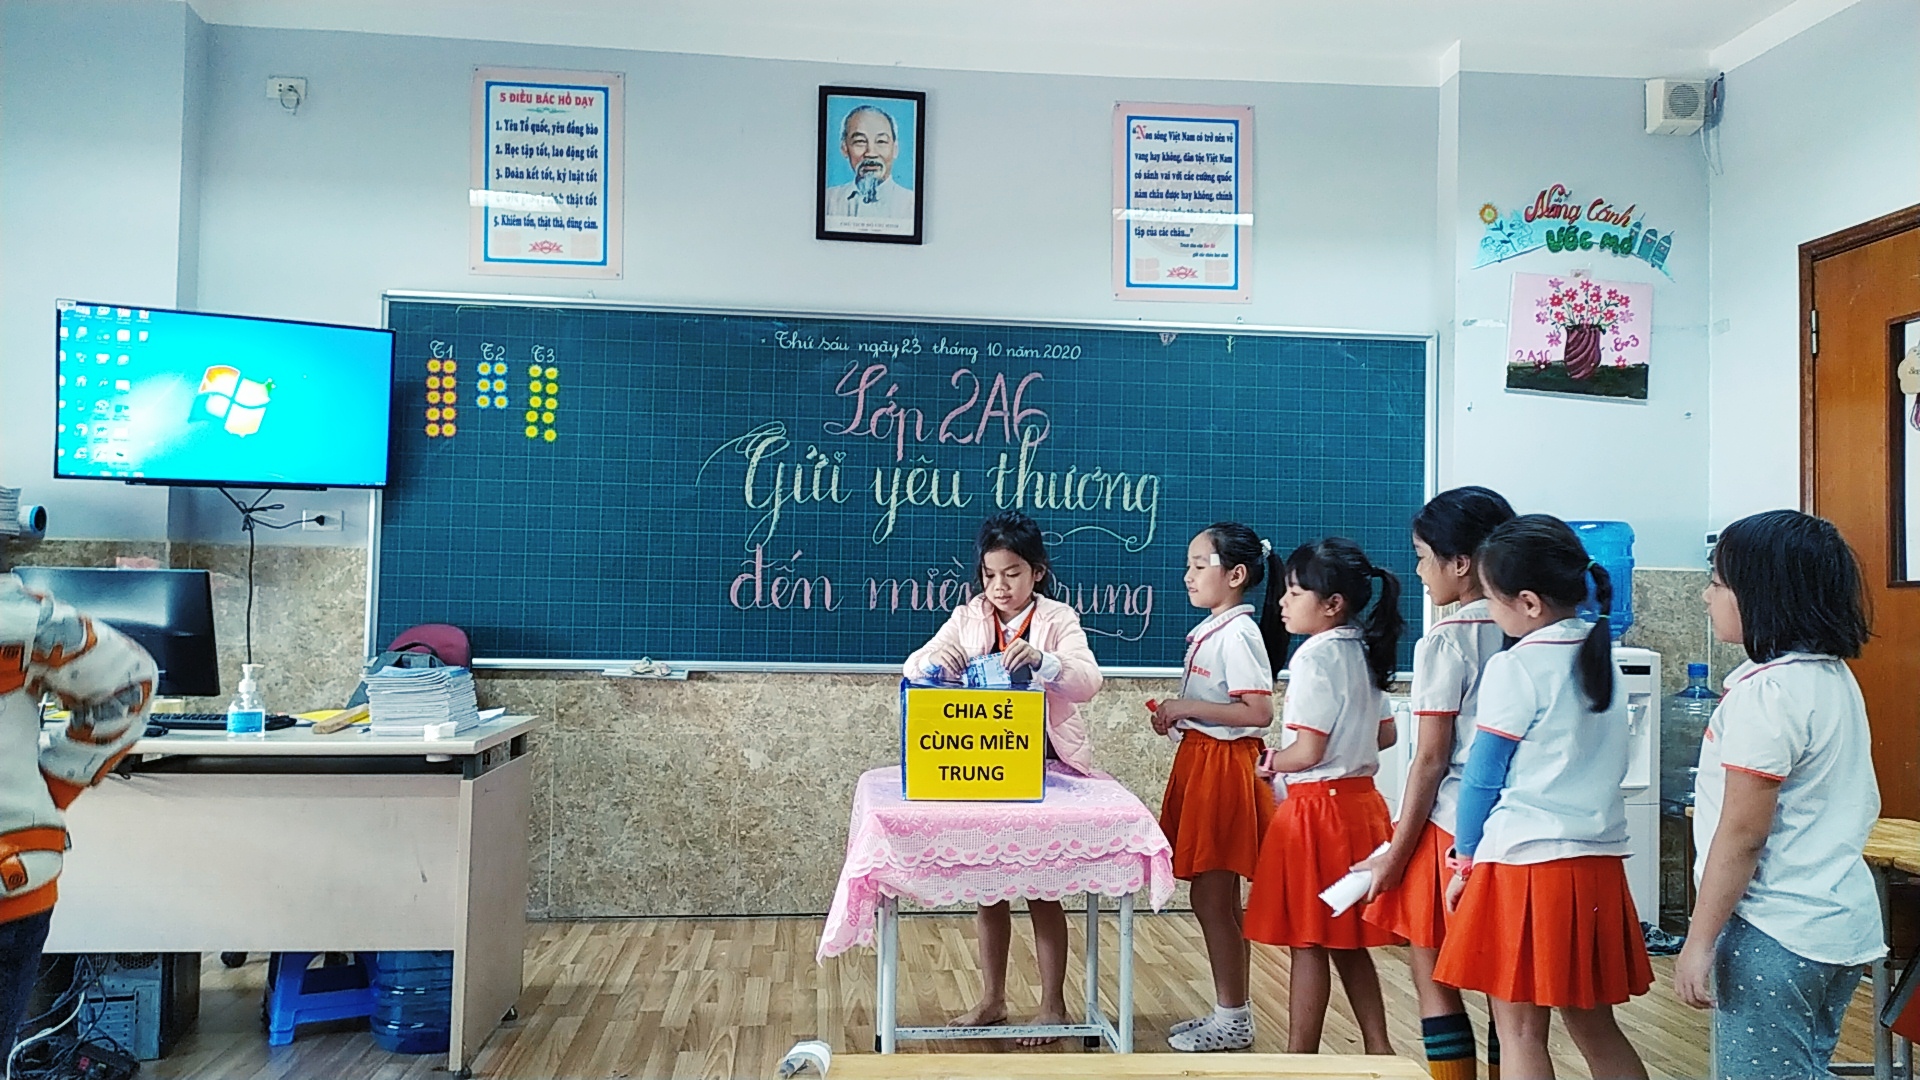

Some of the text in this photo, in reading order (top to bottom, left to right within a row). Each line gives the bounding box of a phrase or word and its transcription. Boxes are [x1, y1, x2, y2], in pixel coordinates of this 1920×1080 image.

[500, 92, 506, 102] 5
[509, 88, 532, 104] ĐIỀU
[536, 92, 555, 104] BÁC
[574, 96, 594, 109] DẠY
[495, 120, 502, 131] 1.
[504, 118, 518, 132] Yêu
[552, 121, 565, 136] yêu
[1182, 132, 1195, 142] Nam
[495, 142, 598, 161] 2. Học tập tốt, lao động tốt
[1134, 152, 1148, 162] vang
[1150, 151, 1160, 162] hay
[1206, 153, 1218, 166] Việt
[1219, 154, 1232, 164] Nam
[495, 168, 503, 180] 3.
[526, 166, 540, 180] kết
[541, 166, 555, 182] tốt,
[568, 169, 584, 184] luật
[586, 168, 598, 182] tốt
[1134, 169, 1142, 180] có
[1160, 170, 1170, 180] vai
[1184, 170, 1194, 181] các
[1216, 170, 1232, 184] quốc
[566, 192, 583, 208] thật
[585, 192, 598, 206] tốt
[1180, 190, 1192, 201] hay
[1586, 198, 1636, 228] Cánh
[1146, 226, 1157, 236] của
[1158, 226, 1168, 236] các
[774, 332, 1082, 364] Thứ sáu ngày 23 tháng 10 năm 2020
[823, 360, 1051, 462] Lớp 2A6
[694, 421, 1159, 553] Gửi yêu thương
[729, 543, 844, 613] đến
[943, 698, 1014, 720] CHIA SẺ
[920, 728, 1029, 750] CÙNG MIỀN
[938, 766, 1004, 781] TRUNG
